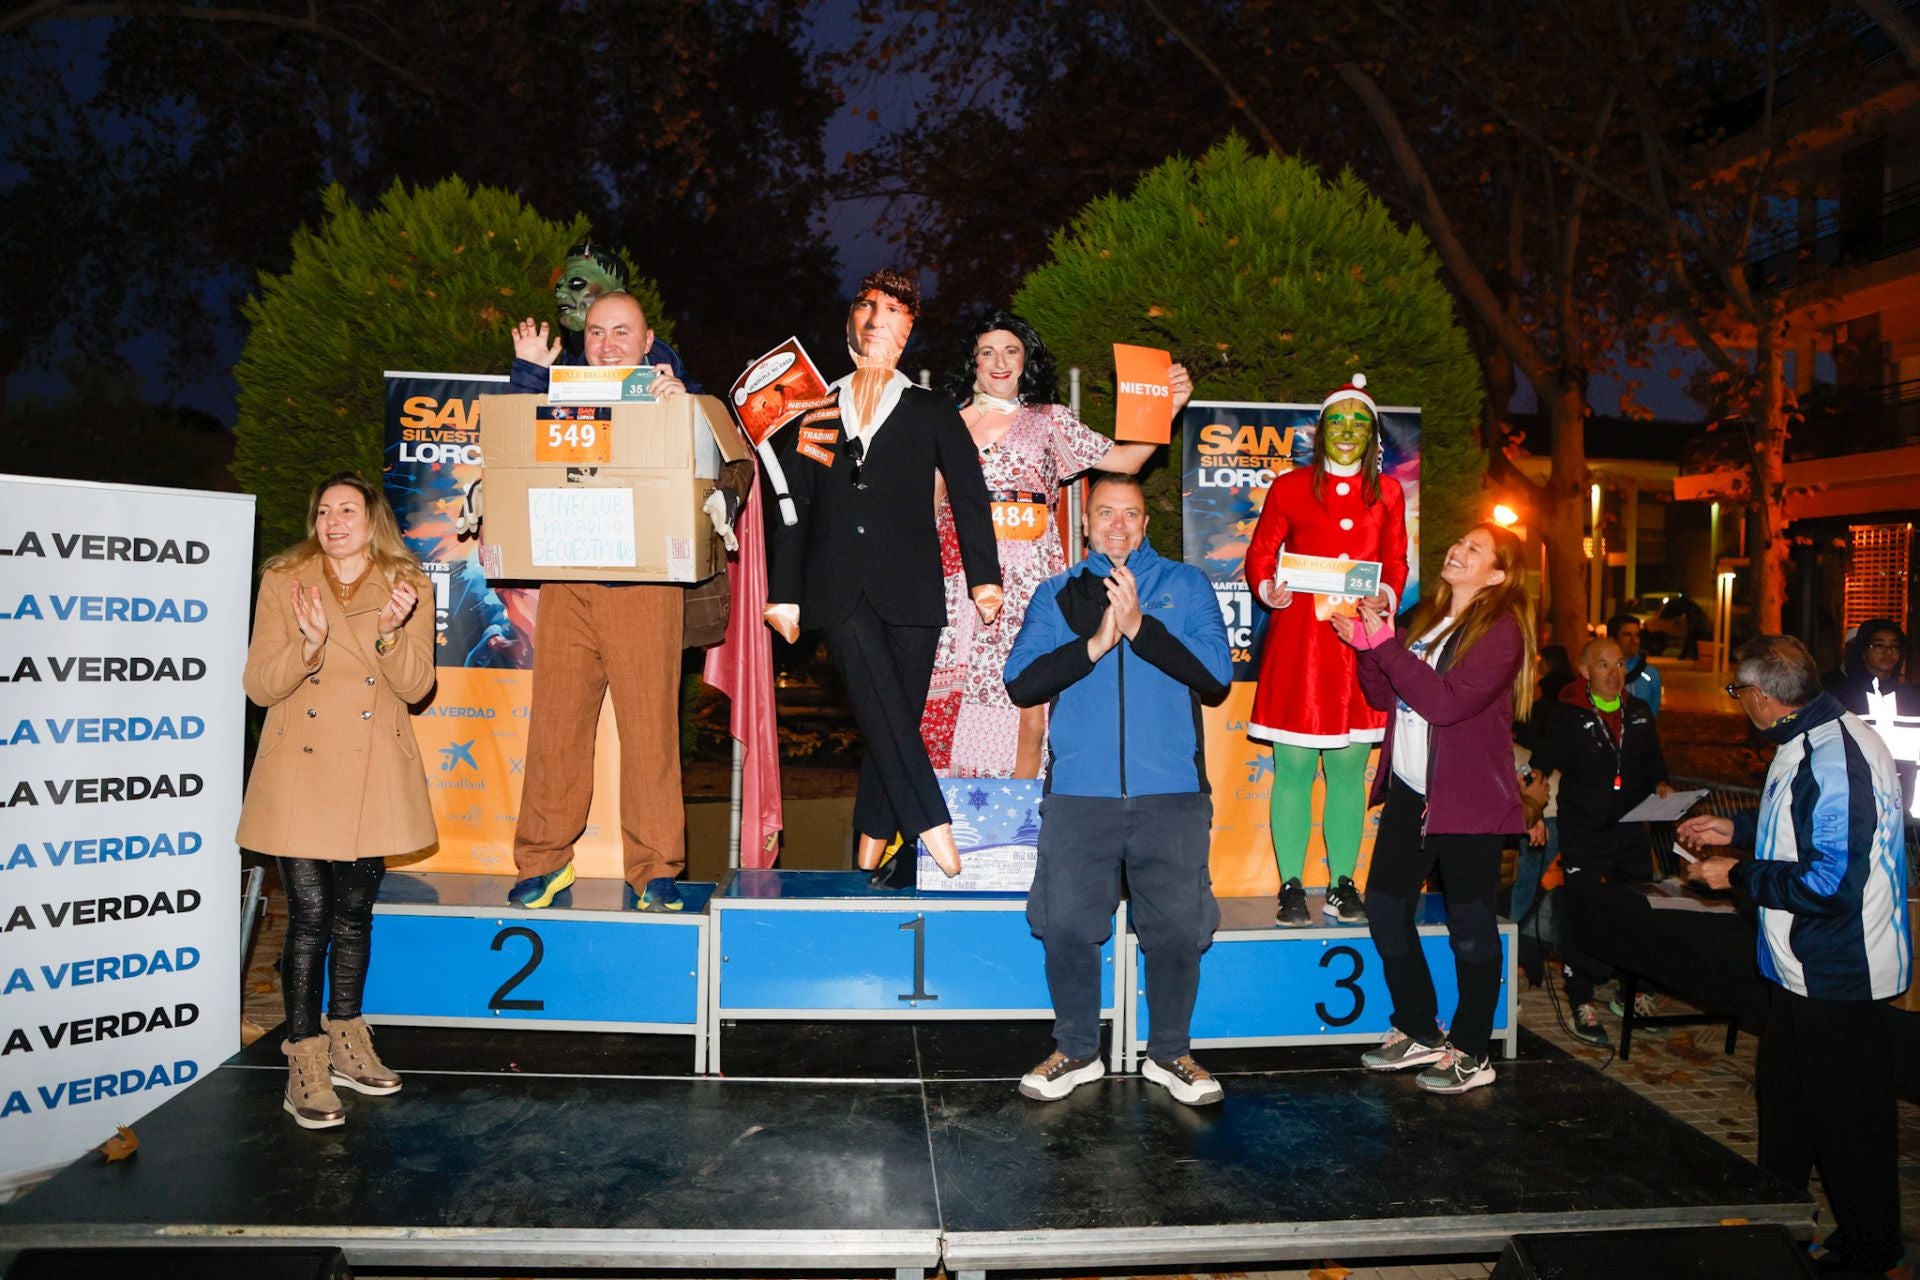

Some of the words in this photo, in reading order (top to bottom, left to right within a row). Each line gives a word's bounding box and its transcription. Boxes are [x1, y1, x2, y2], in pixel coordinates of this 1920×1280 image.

[629, 385, 643, 394] 35
[1120, 381, 1169, 397] NIETOS
[787, 396, 837, 409] NEGOCIOS
[402, 428, 480, 444] SILVEST
[548, 424, 596, 448] 549
[803, 431, 834, 441] TRADING
[1197, 424, 1294, 455] SAN
[399, 442, 481, 465] LORC
[803, 444, 829, 461] DINERO
[1200, 455, 1294, 469] SILVESTRE
[1198, 467, 1293, 488] LORC
[991, 505, 1035, 527] 484
[51, 533, 210, 564] VERDAD
[421, 562, 450, 571] RTES
[431, 572, 450, 609] 1
[1211, 582, 1250, 590] MARTE
[1350, 578, 1363, 587] 25
[1365, 580, 1373, 589] €
[49, 595, 208, 623] VERDAD
[1227, 627, 1252, 648] IC
[1231, 648, 1252, 663] 24
[0, 657, 42, 682] A
[47, 657, 206, 682] VERDAD
[439, 706, 496, 718] VERDAD
[0, 719, 41, 746] A
[45, 716, 205, 744] VERDAD
[1226, 719, 1243, 731] LA
[0, 781, 39, 808] A
[44, 773, 204, 805] VERDAD
[426, 776, 486, 790] CaixaBank
[1235, 786, 1271, 800] Caixa
[0, 843, 37, 871] A
[43, 831, 203, 867] VERDAD
[0, 905, 36, 933] A
[41, 888, 201, 928] VERDAD
[488, 926, 545, 1010] 2
[898, 916, 938, 1000] 1
[0, 968, 35, 996] A
[40, 946, 200, 990] VERDAD
[1314, 946, 1365, 1027] 3
[0, 1028, 34, 1056] A
[38, 1003, 200, 1050] VERDAD
[0, 1090, 33, 1119] A
[37, 1059, 199, 1111] VERDAD
